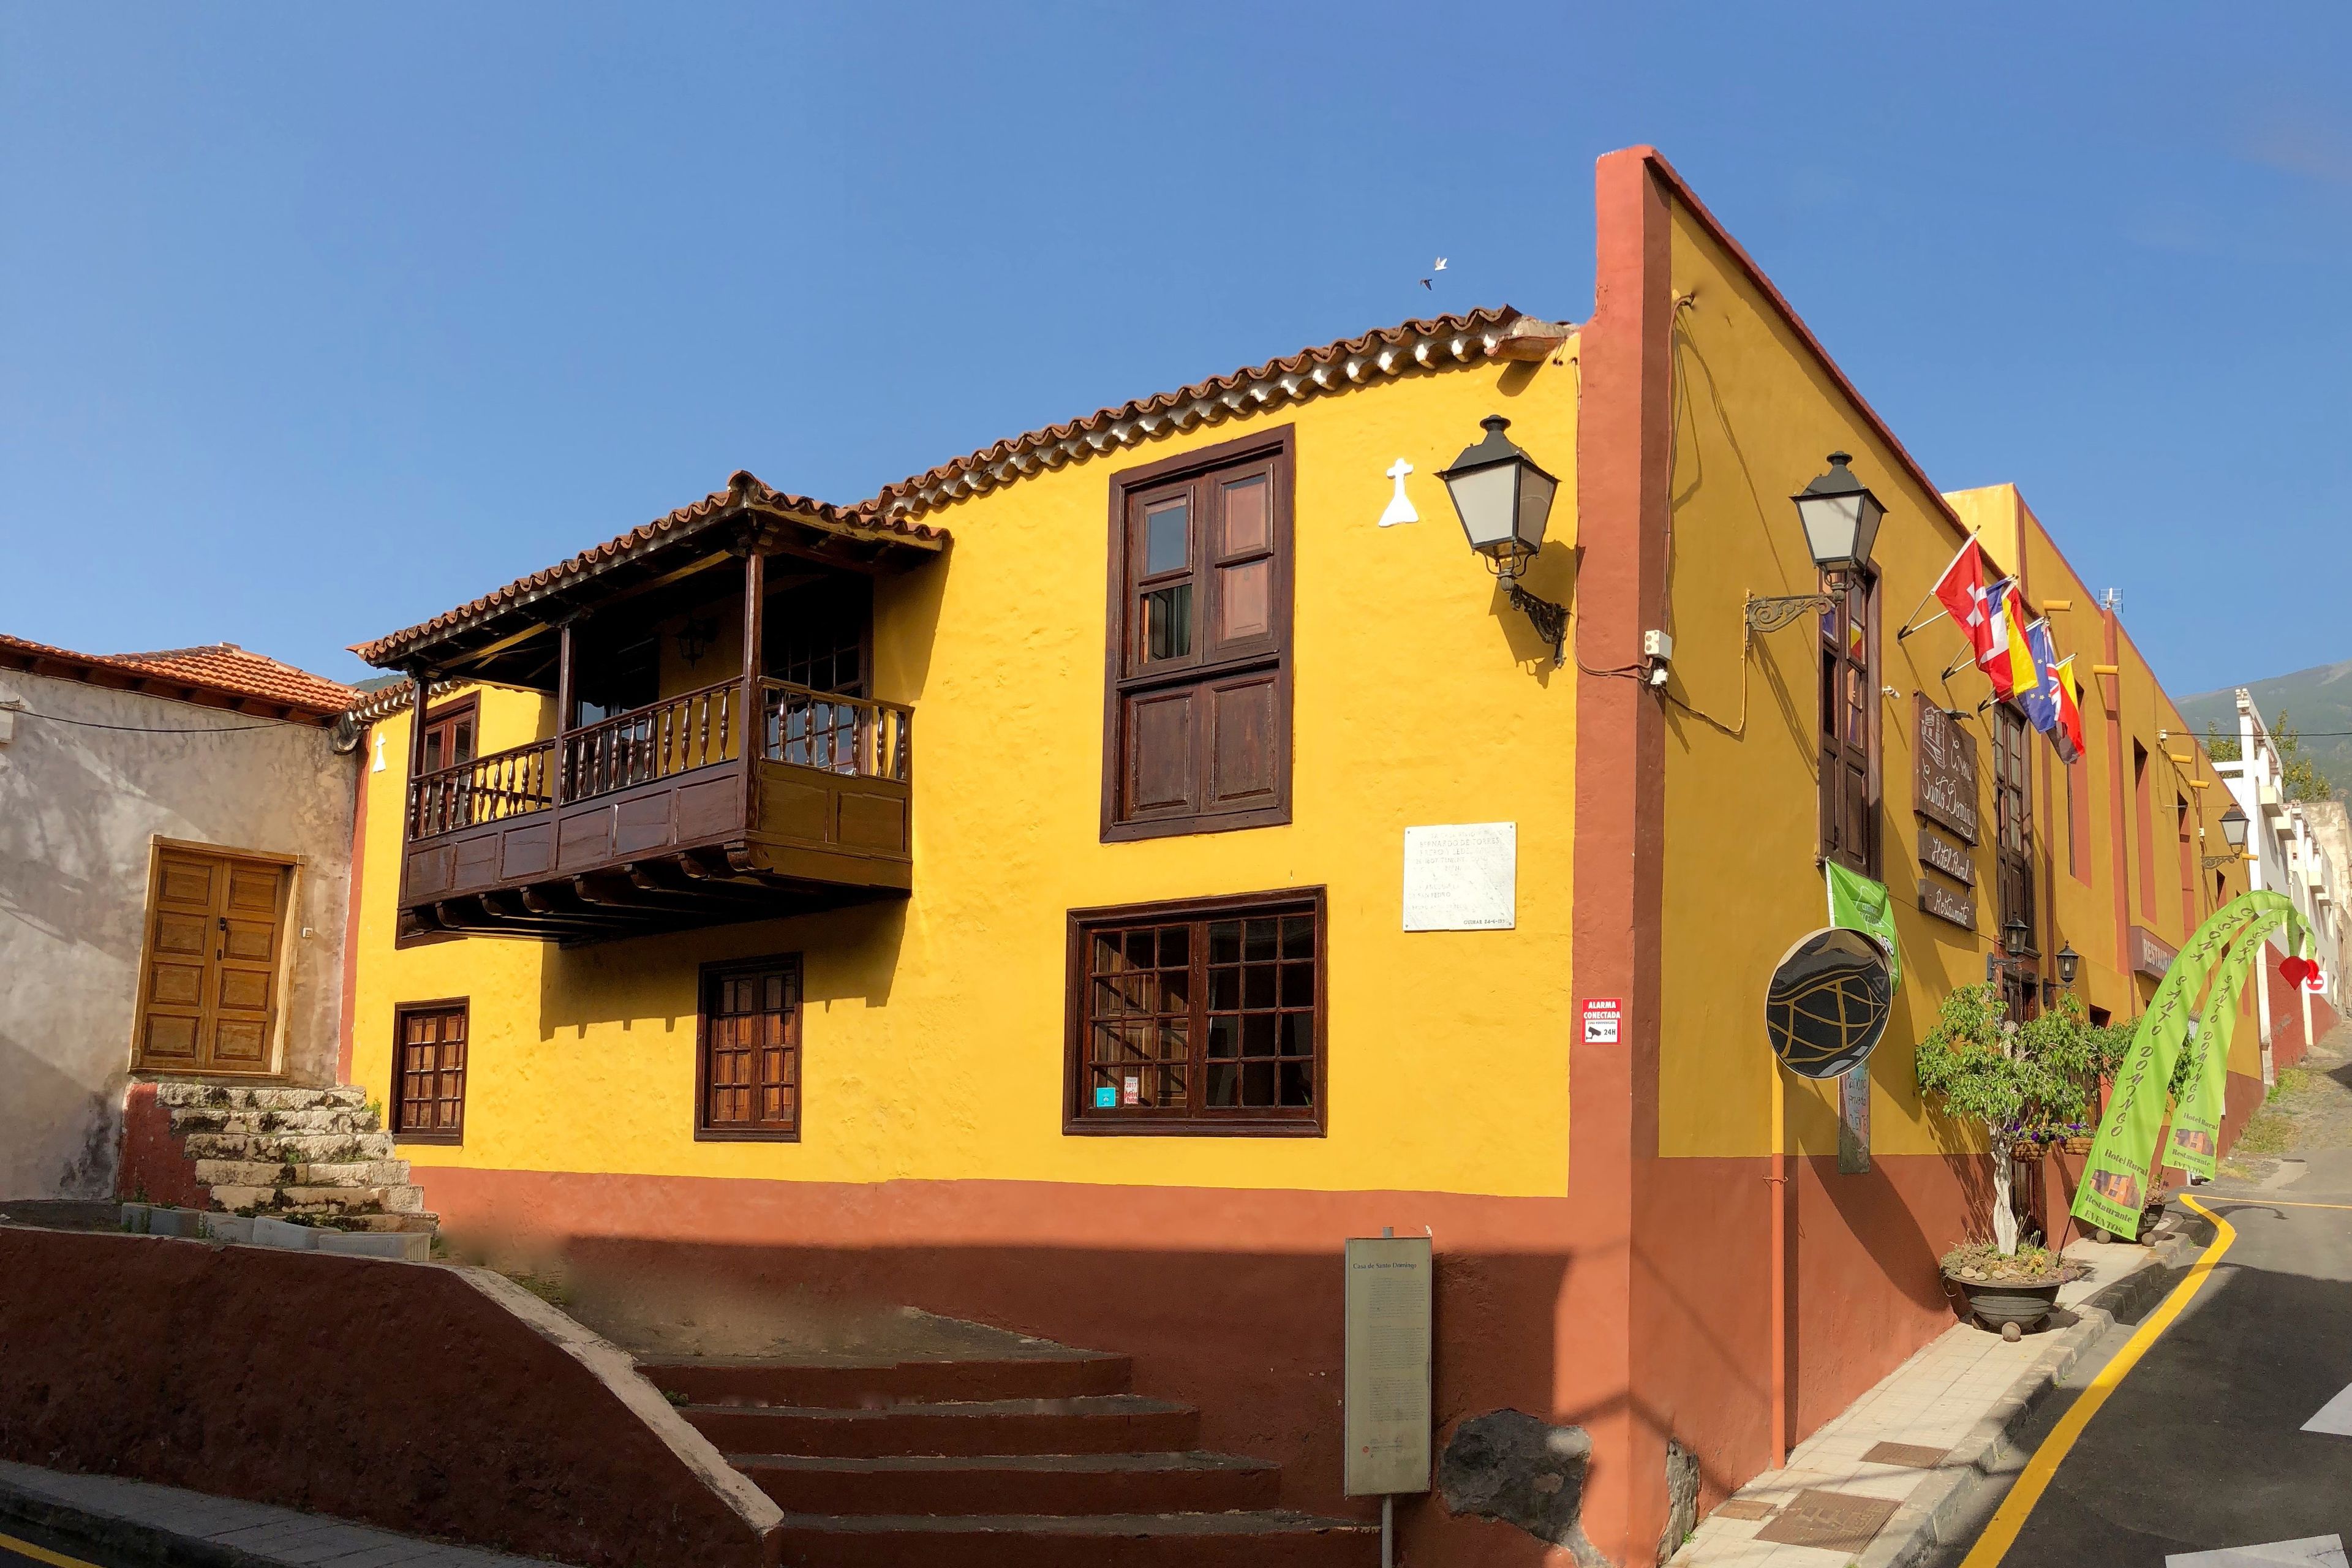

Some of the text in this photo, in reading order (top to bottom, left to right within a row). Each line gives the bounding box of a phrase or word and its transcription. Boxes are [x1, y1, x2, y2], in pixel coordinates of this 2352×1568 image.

[1922, 758, 1948, 810] Santo
[1931, 837, 1952, 871] Hotel
[1934, 888, 1969, 925] Restaurante
[2189, 907, 2253, 963] CASONA
[2233, 921, 2278, 964] CASONA
[1588, 1001, 1616, 1009] ALARMA
[2151, 975, 2187, 1036] SANTO
[2210, 975, 2233, 1023] SANTO
[2186, 1031, 2213, 1103] DOMINGO
[2111, 1046, 2154, 1137] DOMINGO
[2183, 1112, 2218, 1130] Hotel Rural
[2105, 1148, 2149, 1177] Hotel Rural
[2172, 1148, 2211, 1166] Restaurante
[2084, 1210, 2124, 1234] EVENTOS
[2085, 1194, 2133, 1223] Restaurante
